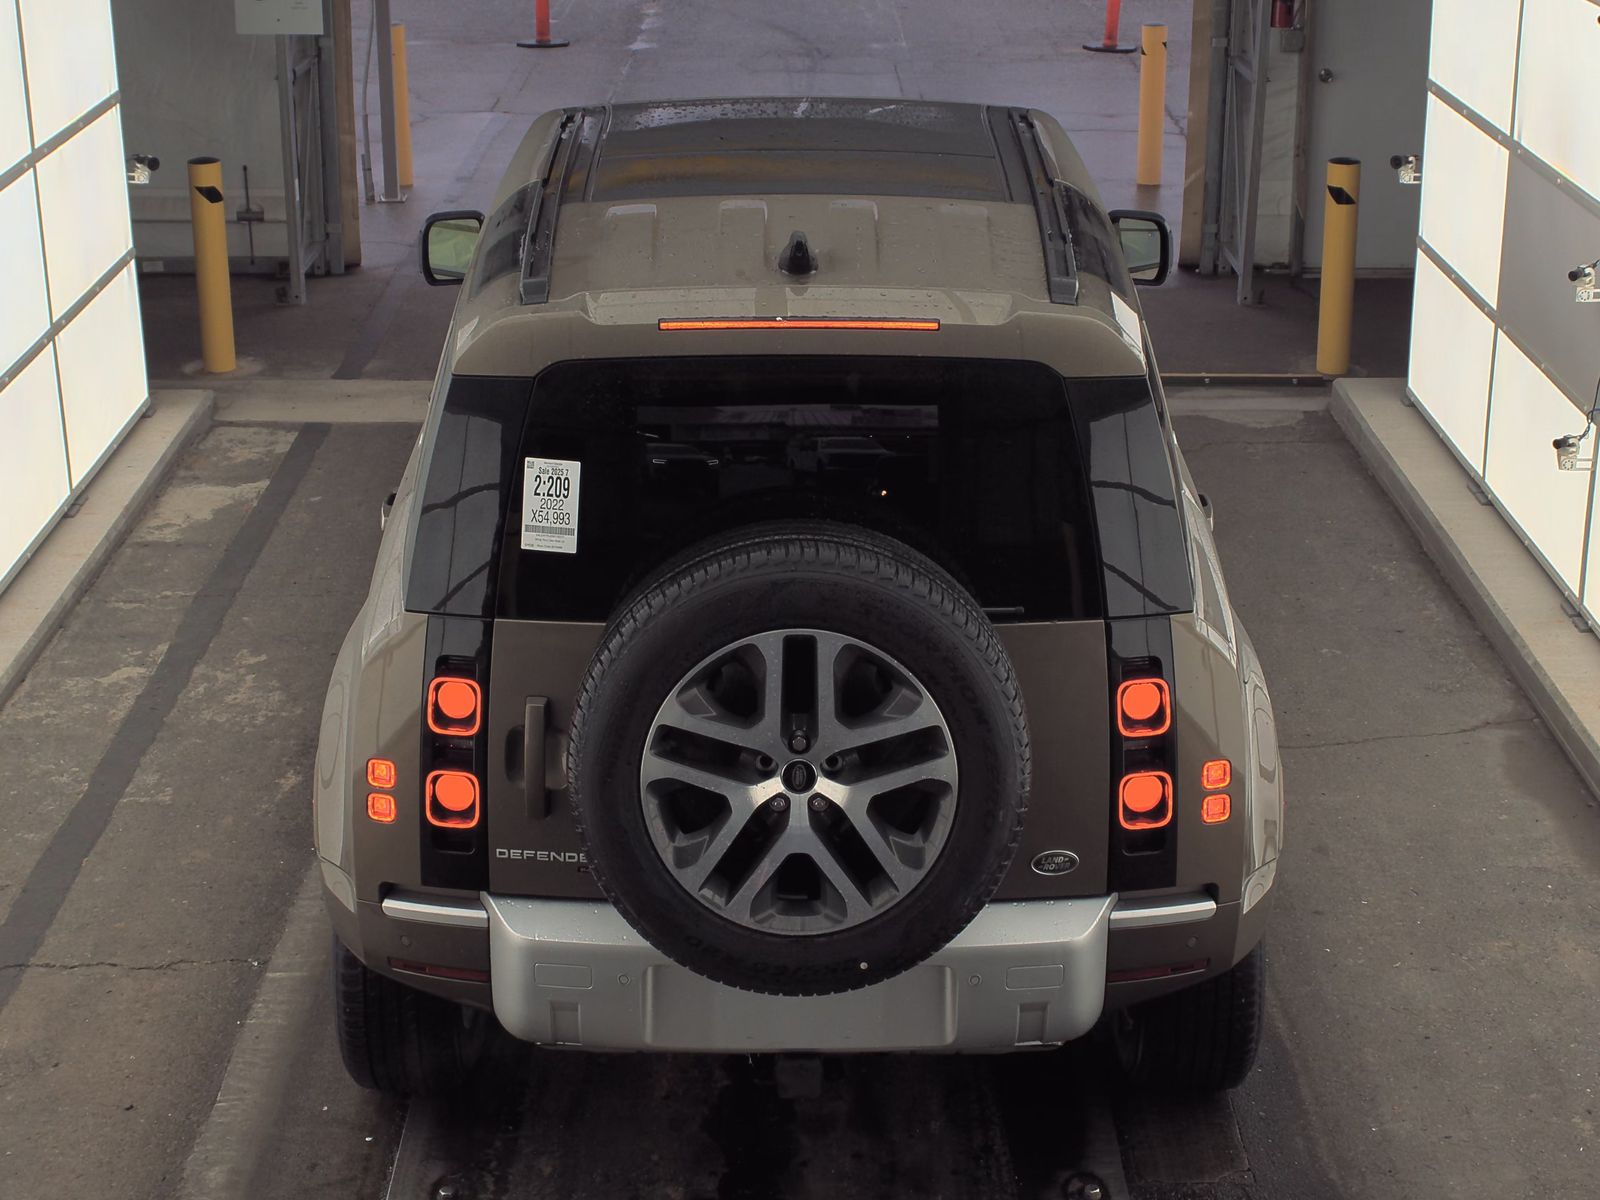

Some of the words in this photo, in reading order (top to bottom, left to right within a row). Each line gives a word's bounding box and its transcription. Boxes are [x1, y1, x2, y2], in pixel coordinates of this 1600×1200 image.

[538, 467, 550, 475] Sale
[551, 468, 564, 476] 2025
[534, 475, 570, 499] 2:209
[540, 498, 564, 511] 2022
[531, 509, 571, 525] X54,993
[496, 848, 588, 863] DEFENDE
